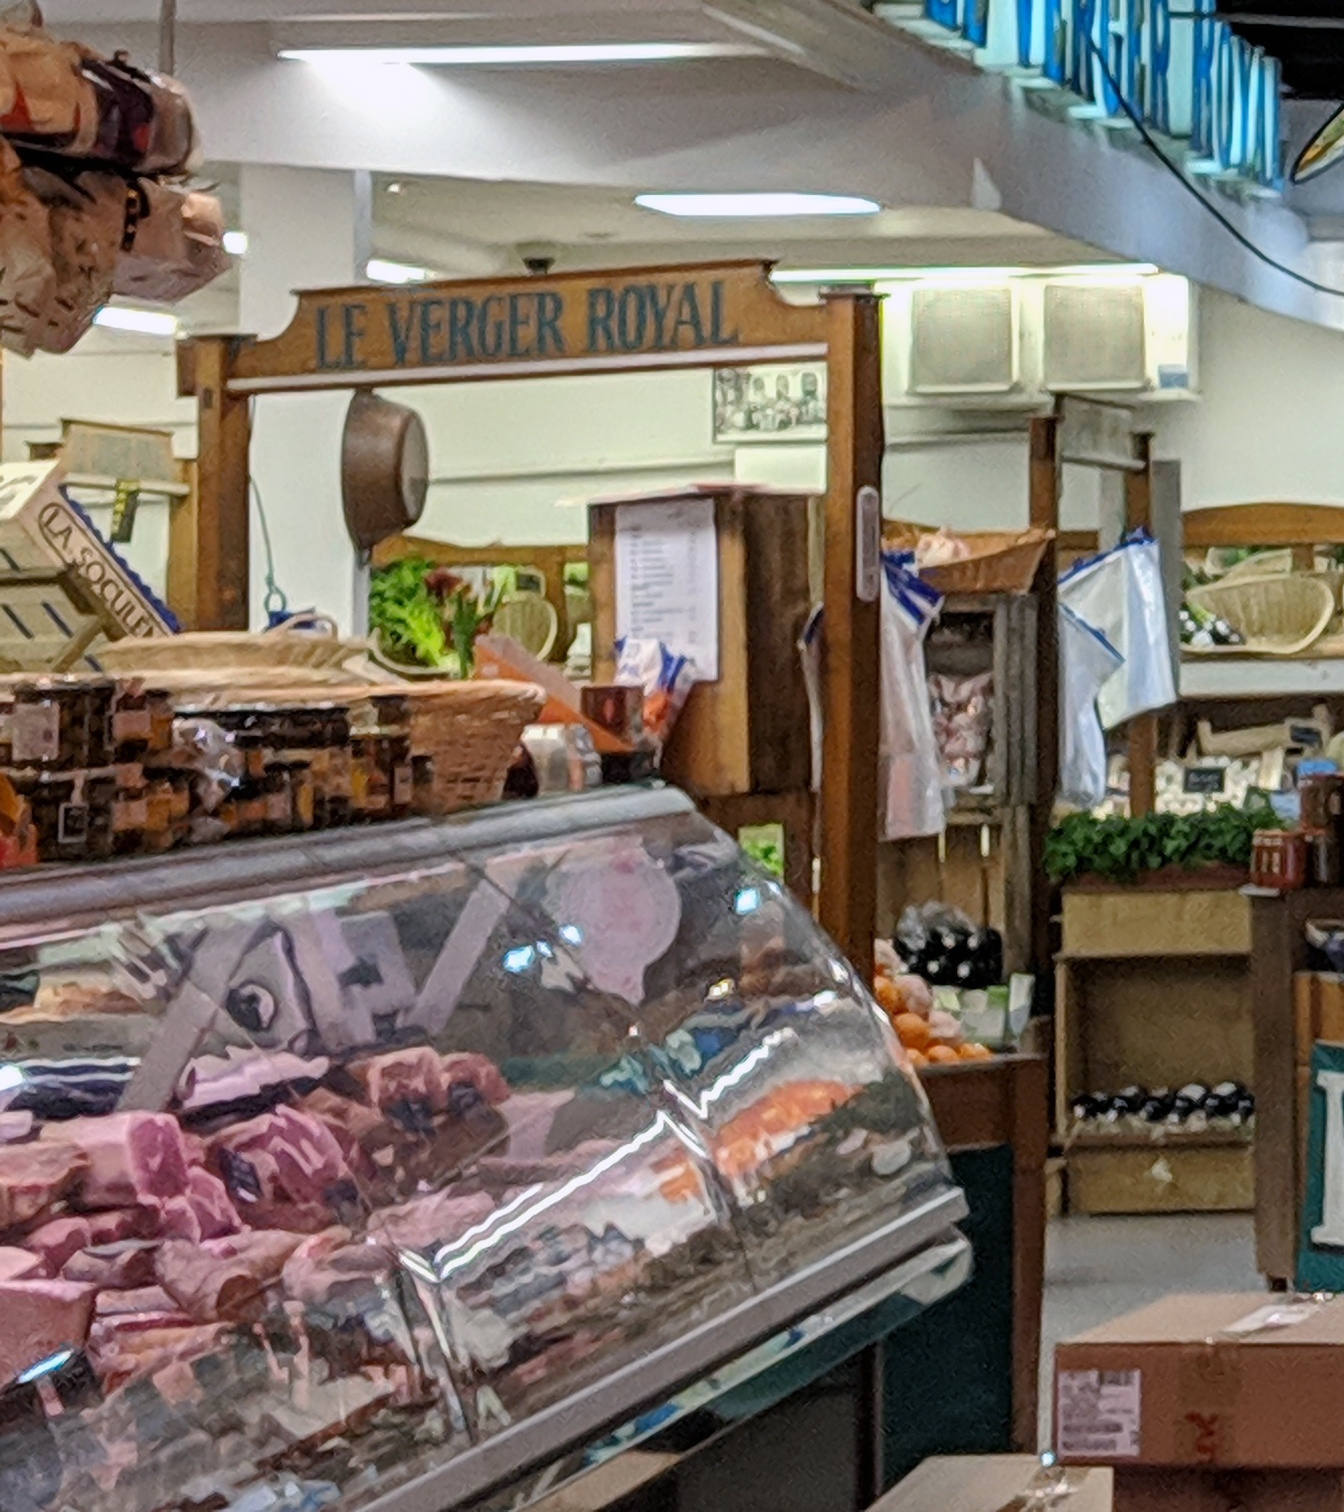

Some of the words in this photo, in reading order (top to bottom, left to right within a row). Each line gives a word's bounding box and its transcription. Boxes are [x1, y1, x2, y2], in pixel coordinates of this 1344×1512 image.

[315, 303, 367, 369] LE
[386, 291, 567, 367] VERGER
[586, 279, 738, 353] ROYAL
[43, 508, 73, 550] LA
